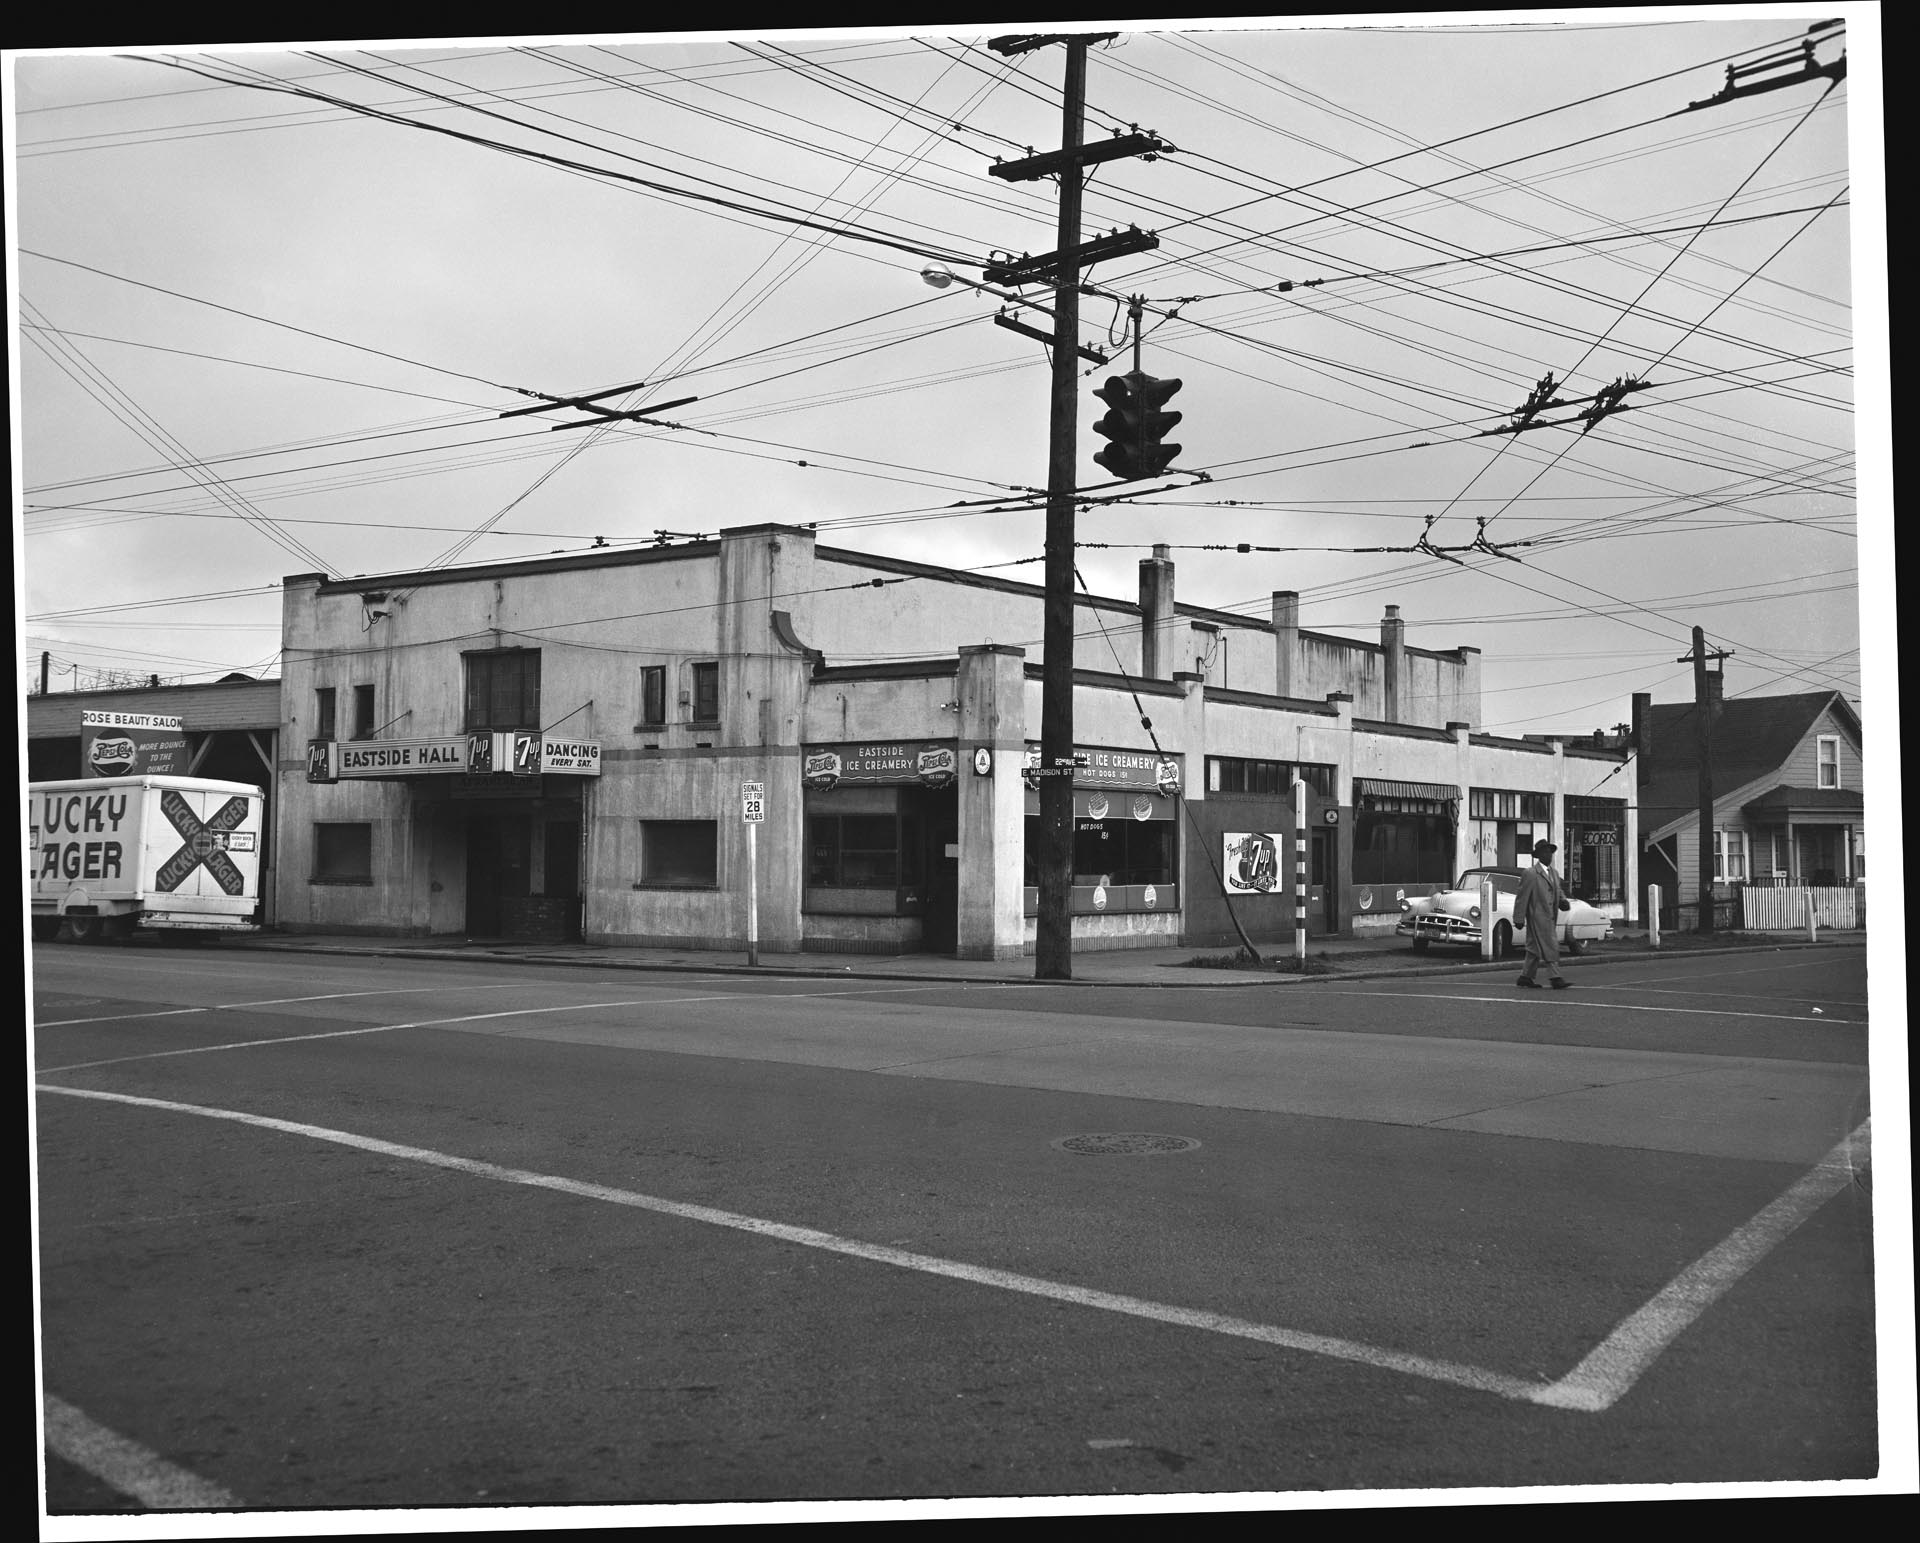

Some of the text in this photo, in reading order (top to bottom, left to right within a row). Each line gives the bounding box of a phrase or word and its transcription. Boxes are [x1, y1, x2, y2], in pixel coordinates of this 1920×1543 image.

[83, 713, 111, 723] ROSE
[115, 715, 150, 726] BEAUTY
[546, 743, 598, 758] DANCING
[859, 747, 904, 757] EASTSIDE
[150, 753, 173, 762] TO THE
[344, 746, 460, 768] EASTSIDE HALL
[1095, 754, 1109, 767] ICE
[1112, 755, 1155, 770] CREAMERY
[551, 758, 592, 768] EVERY SAT.
[847, 759, 913, 771] ICE CREAMERY
[1030, 768, 1061, 776] MADISON
[1082, 769, 1096, 777] HOT
[1099, 769, 1116, 778] DOGS
[743, 792, 763, 800] SET FOR
[747, 801, 760, 812] 28
[744, 812, 763, 820] MILES
[158, 847, 197, 890] LUCKY
[209, 799, 248, 831] AGER
[162, 793, 200, 836] LUCKY
[206, 849, 242, 894] LAGER
